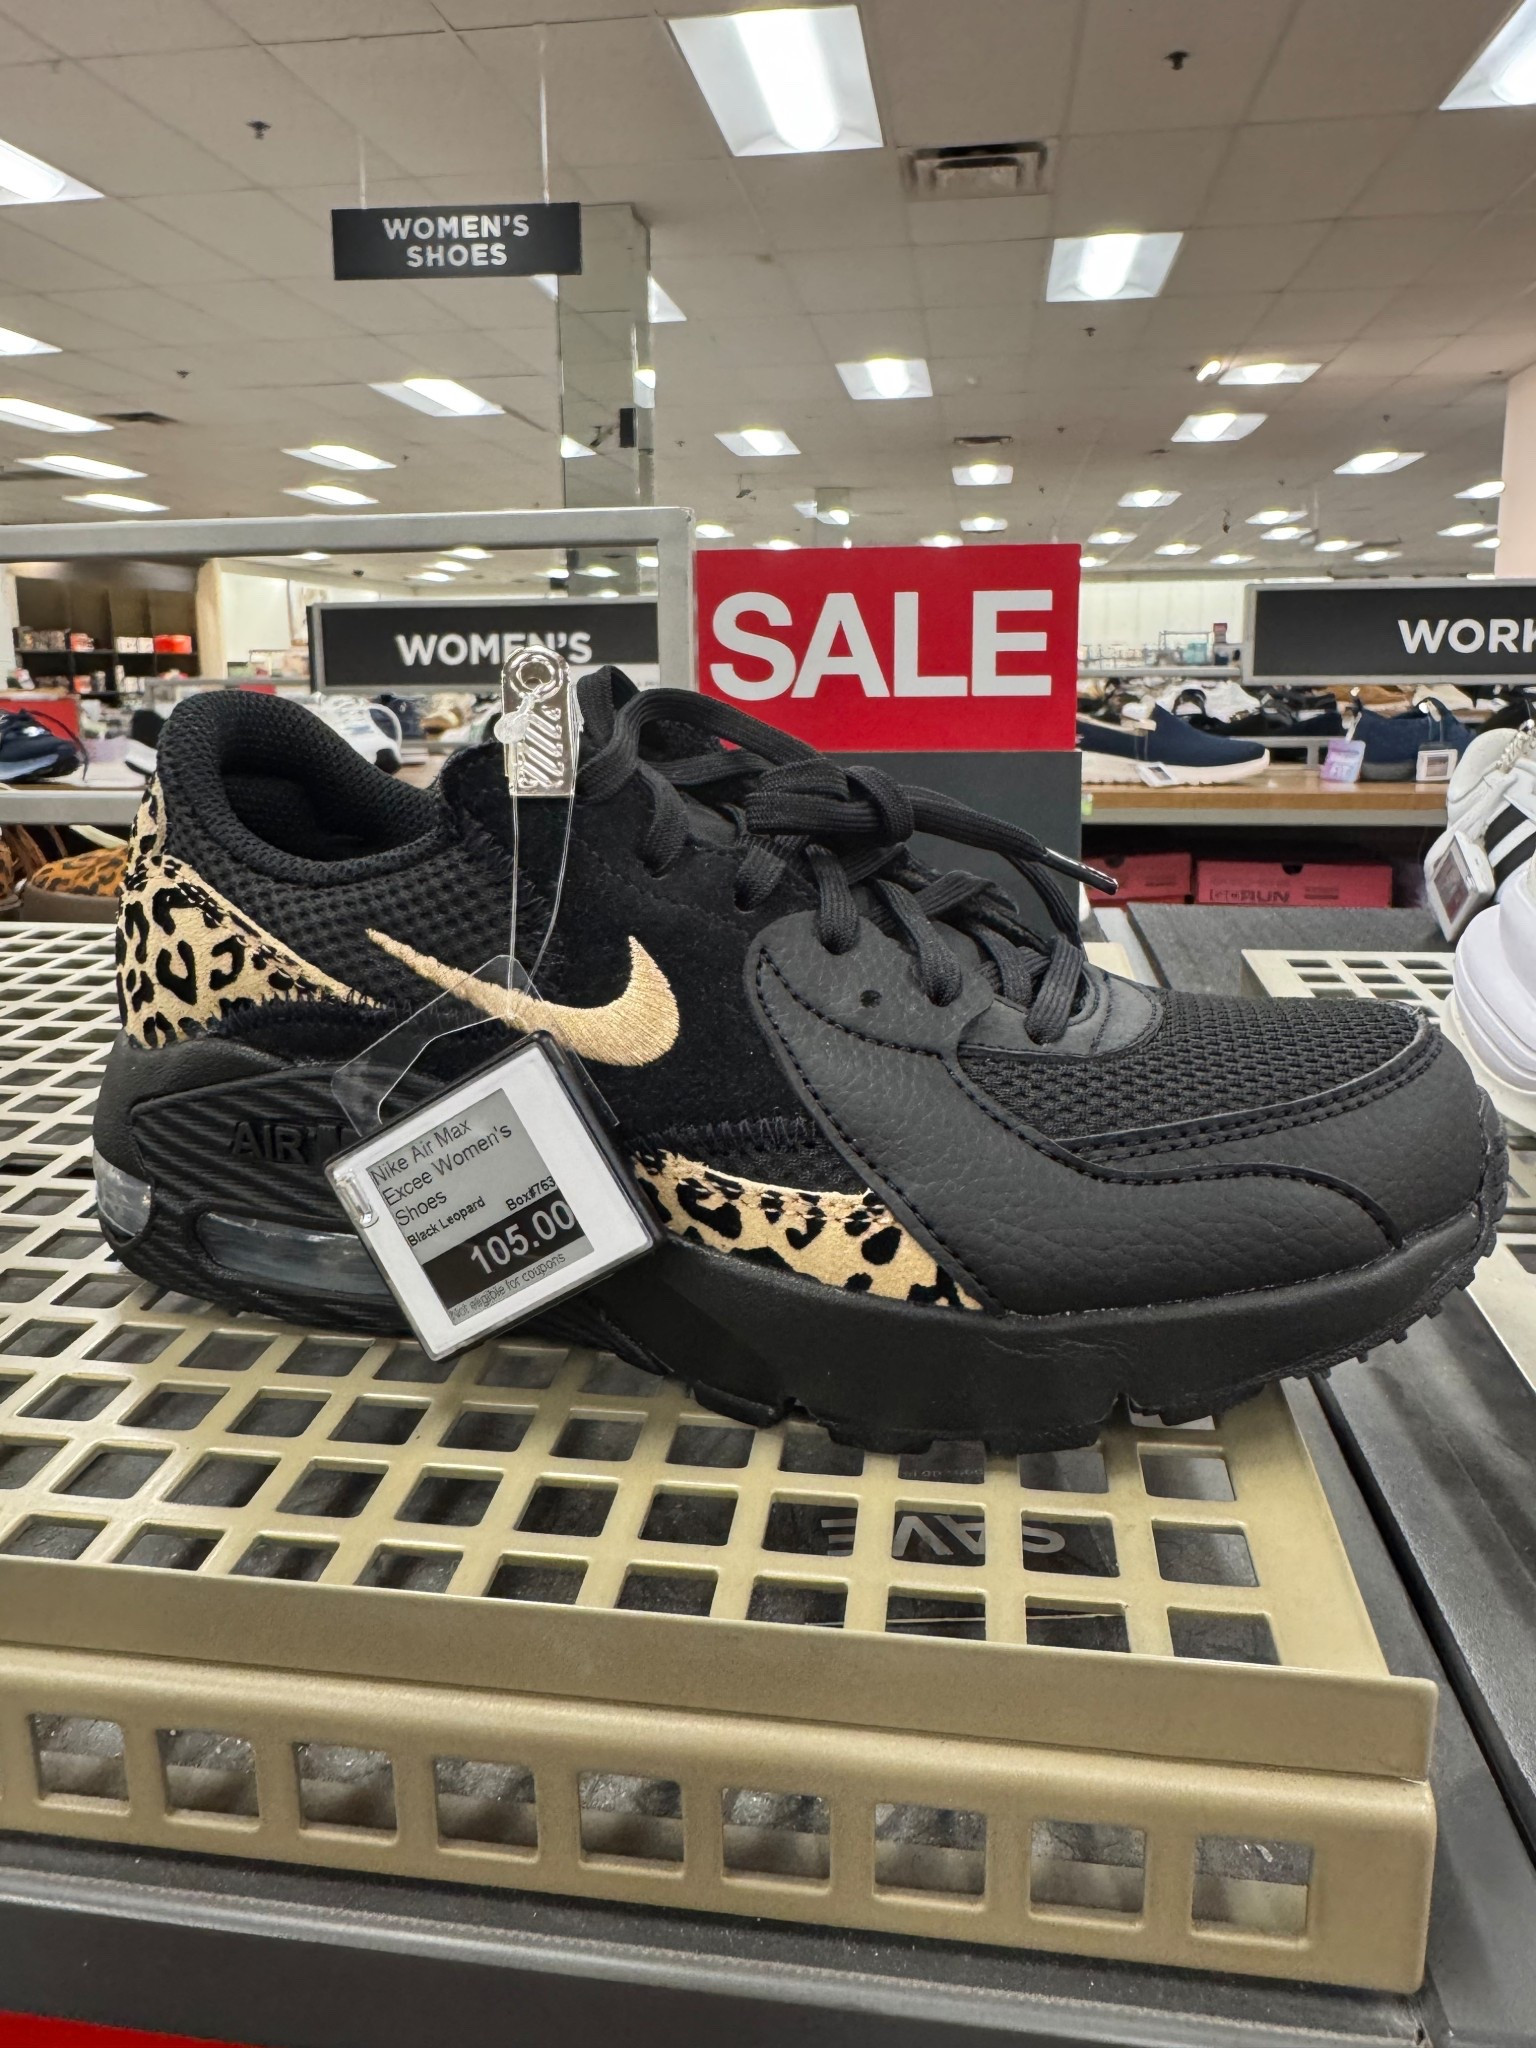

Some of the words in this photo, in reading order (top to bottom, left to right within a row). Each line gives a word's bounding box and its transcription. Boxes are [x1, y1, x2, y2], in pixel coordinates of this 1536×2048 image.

[382, 214, 530, 240] WOMEN'S
[406, 243, 508, 268] SHOES
[709, 589, 1053, 701] SALE
[370, 1157, 409, 1186] Nike
[411, 1141, 434, 1163] Air
[433, 1120, 472, 1148] Max
[382, 1171, 433, 1207] Excee
[431, 1125, 512, 1176] Women's
[395, 1191, 447, 1226] Shoes
[406, 1223, 440, 1247] Black
[439, 1196, 486, 1229] Leopard
[471, 1200, 576, 1274] 105.00
[504, 1276, 521, 1291] for
[521, 1253, 566, 1278] coupons
